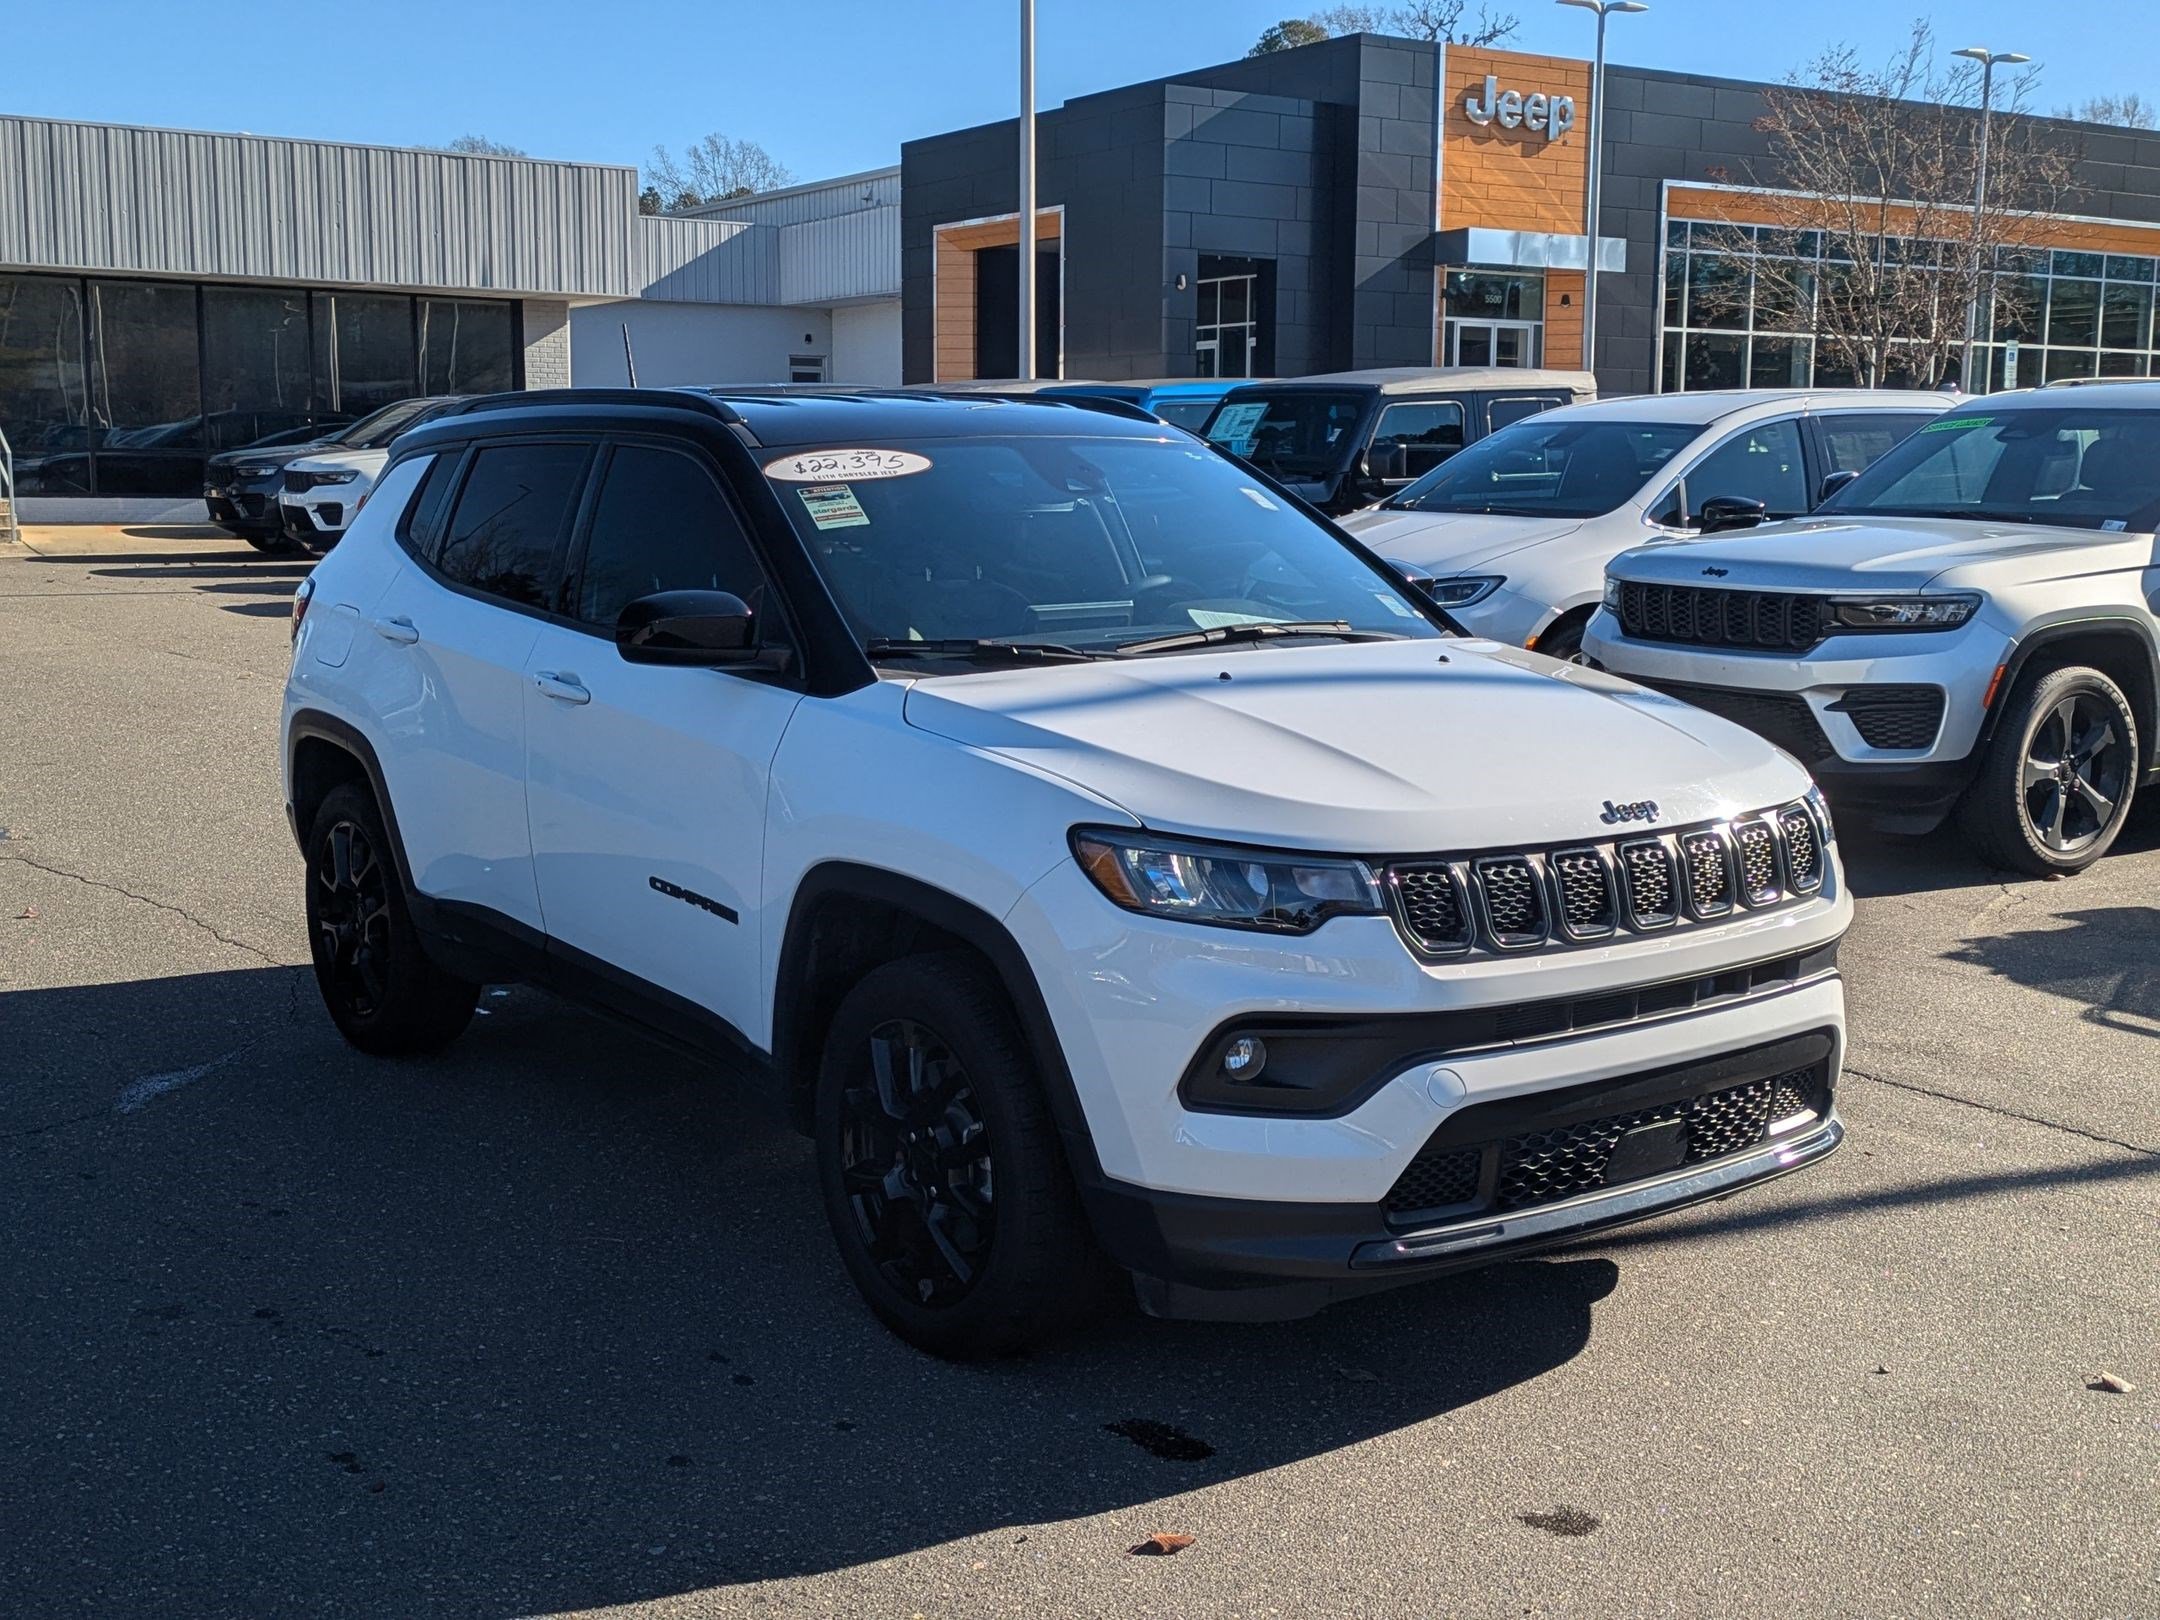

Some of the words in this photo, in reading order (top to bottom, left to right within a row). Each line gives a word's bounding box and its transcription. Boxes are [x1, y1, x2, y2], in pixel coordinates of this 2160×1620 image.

[1466, 75, 1575, 141] Jeep
[794, 454, 904, 474] $22,395
[813, 473, 836, 481] LEITH
[1702, 566, 1729, 578] Jeep
[1599, 800, 1660, 824] Jeep
